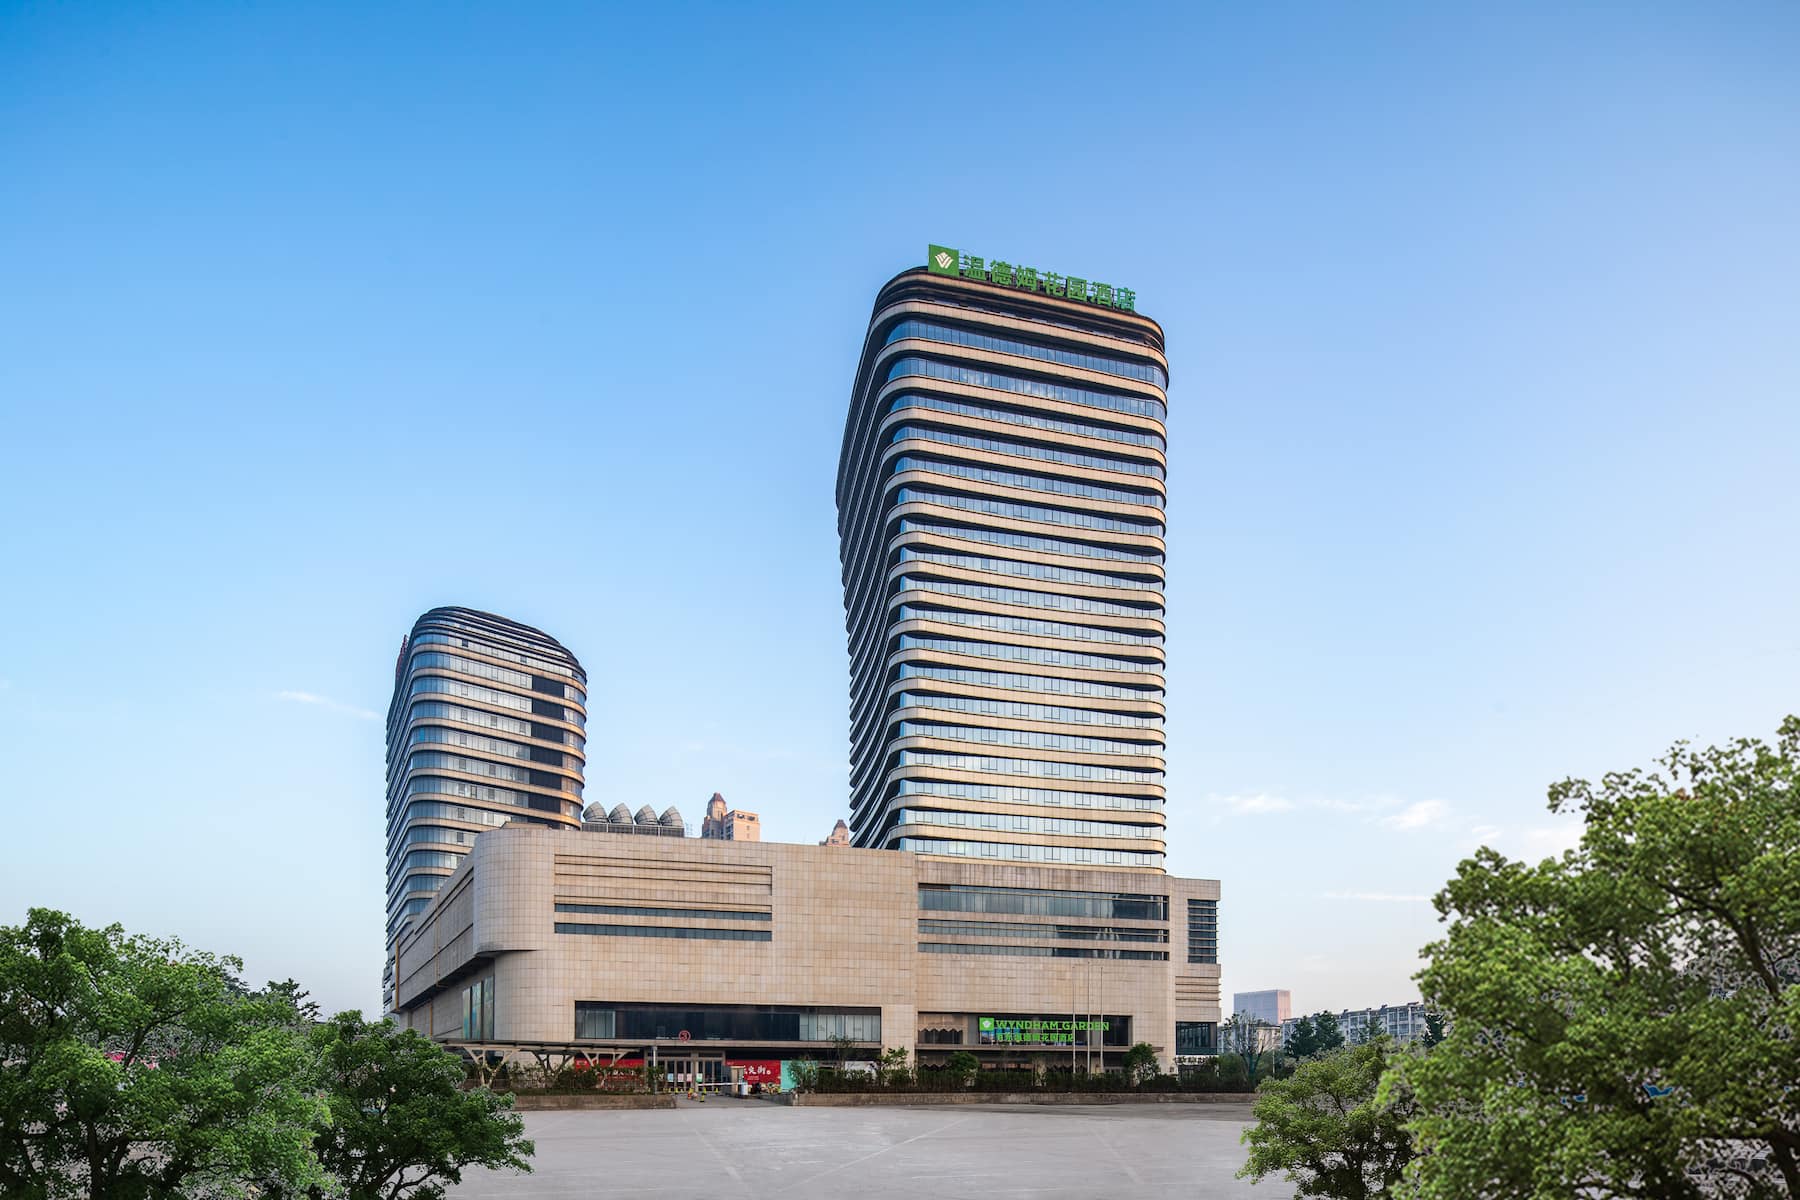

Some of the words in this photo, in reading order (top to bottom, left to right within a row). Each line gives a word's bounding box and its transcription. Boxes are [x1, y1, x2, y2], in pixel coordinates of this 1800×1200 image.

[963, 254, 1136, 312] 温德姆花园酒店
[996, 1020, 1059, 1030] WYNDHAM
[1061, 1021, 1110, 1031] GARDEN
